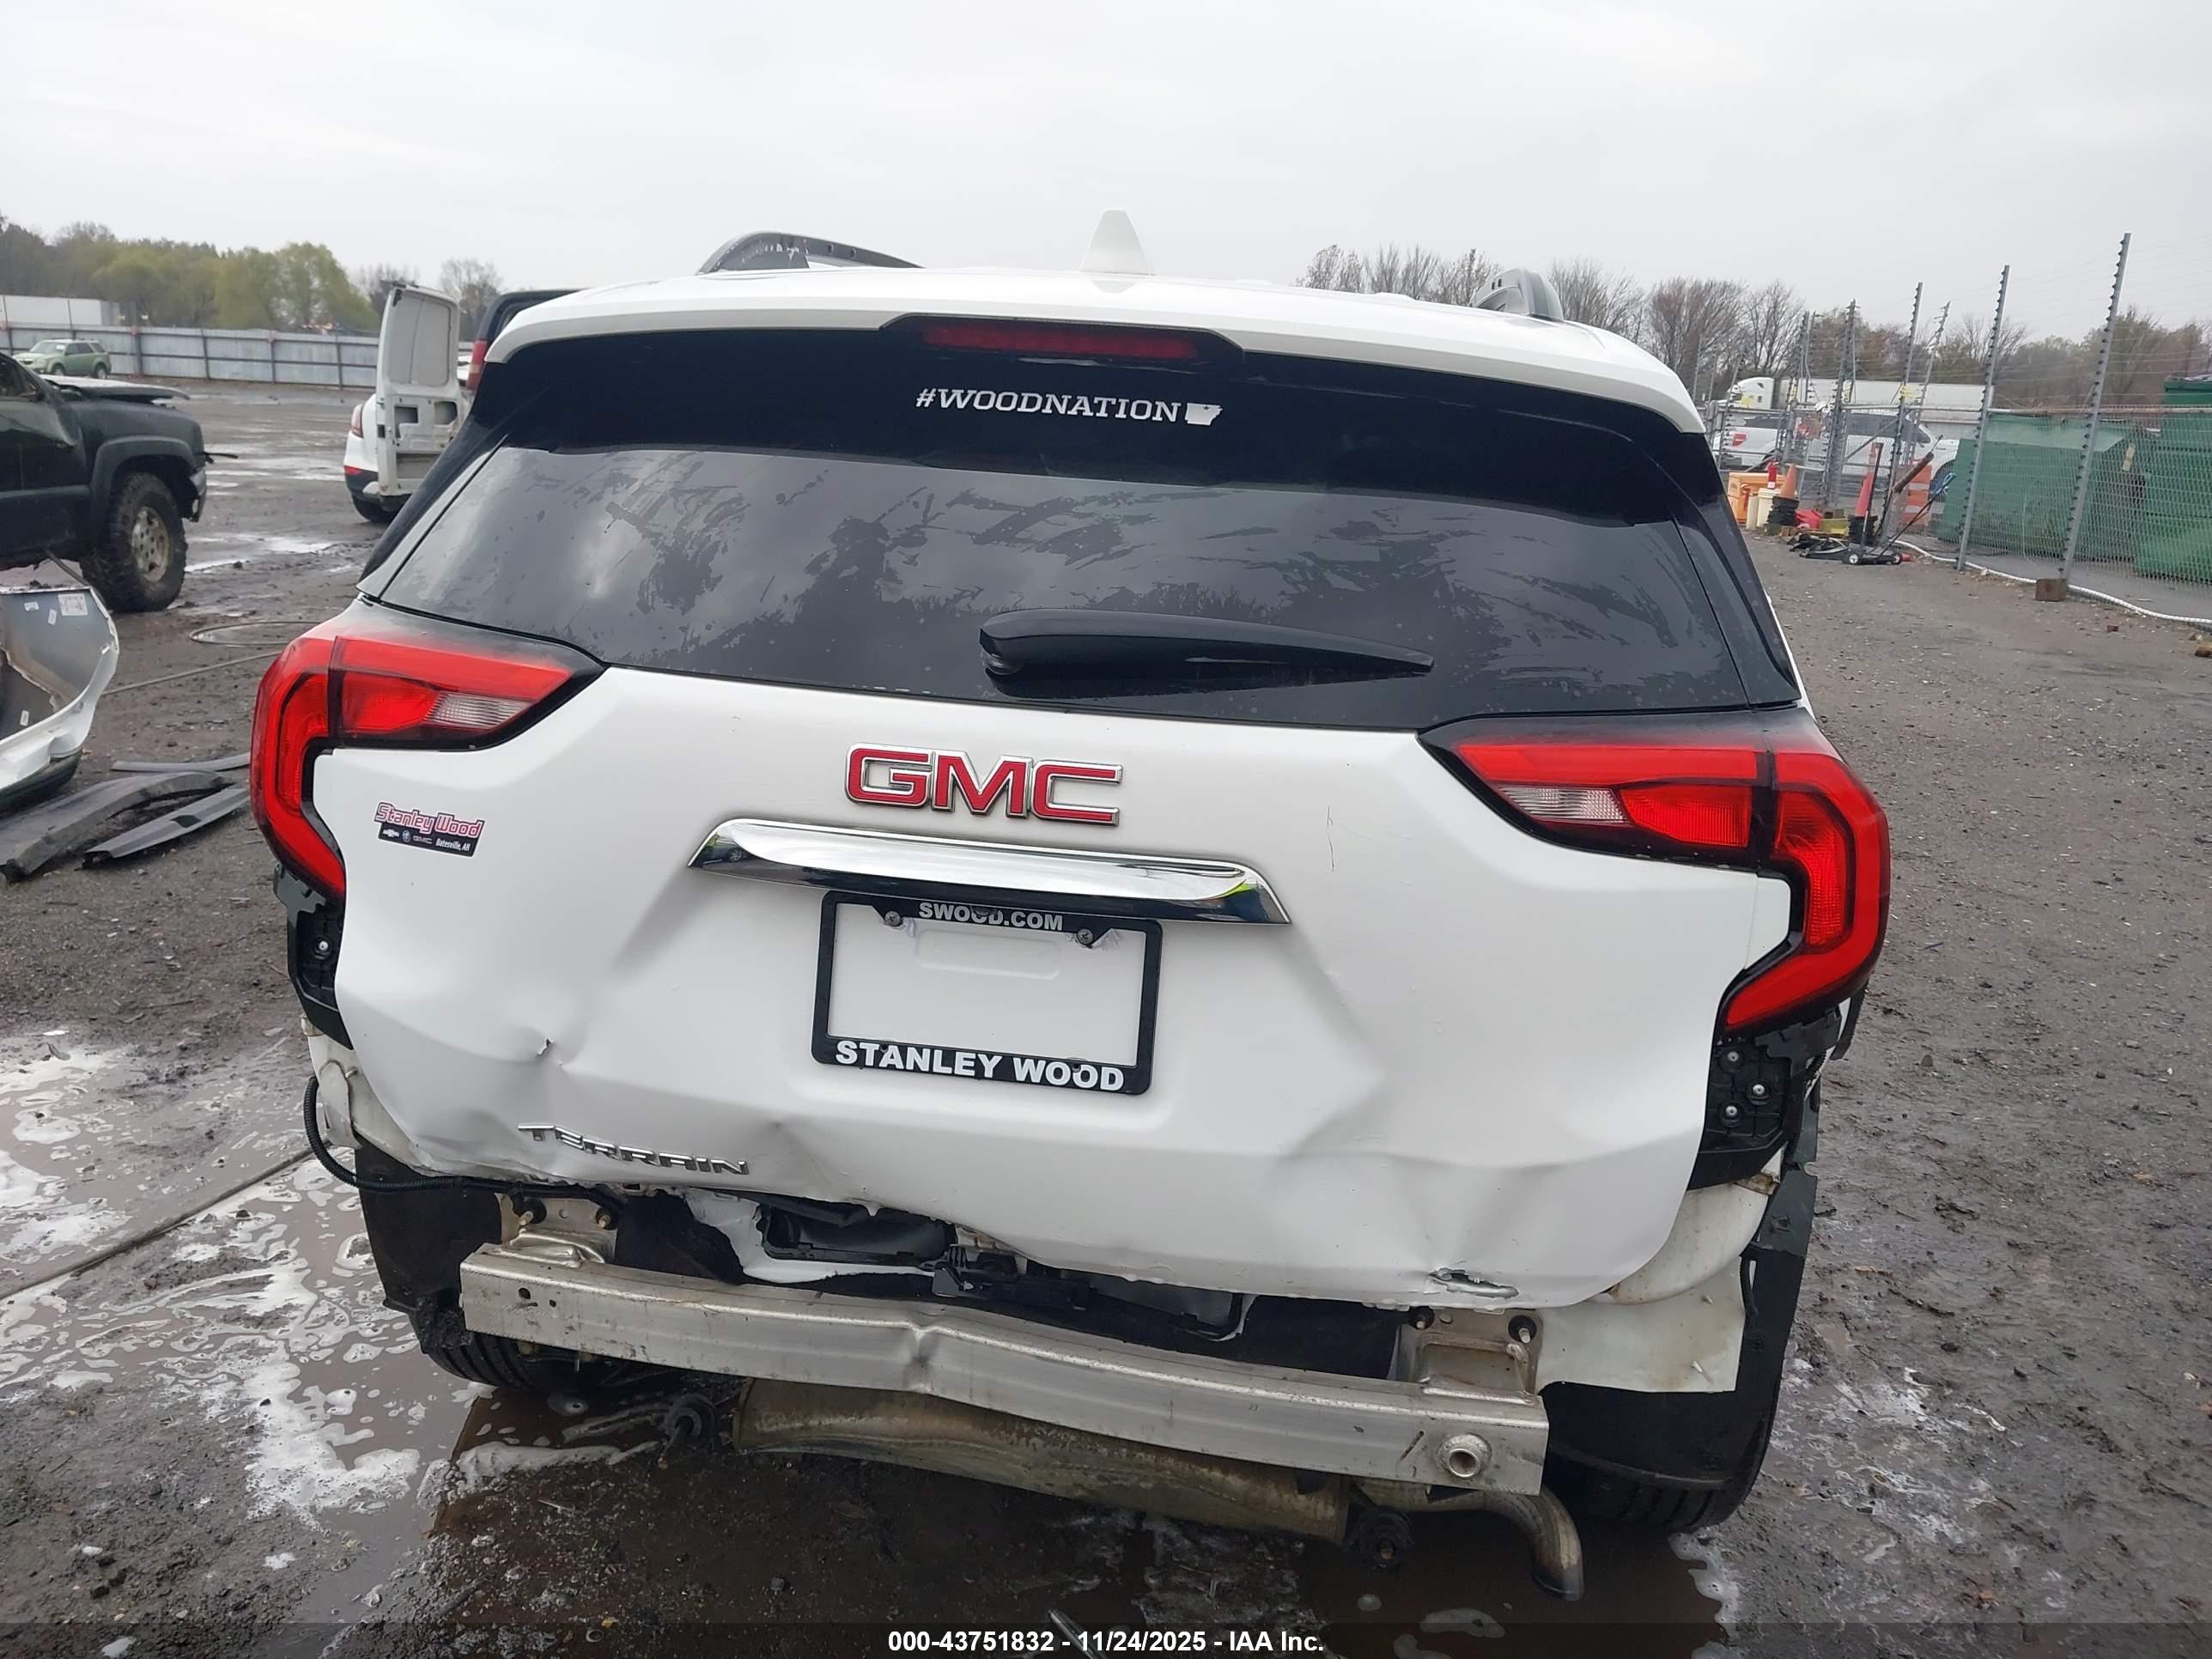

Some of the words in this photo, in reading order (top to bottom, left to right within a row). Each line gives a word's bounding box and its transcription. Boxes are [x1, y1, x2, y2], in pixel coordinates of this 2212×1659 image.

[915, 388, 1182, 422] #WOODNATION
[845, 743, 1123, 826] GMC
[376, 803, 434, 834] Stanley
[435, 813, 483, 837] Wood
[919, 902, 1063, 932] SWOOD.COM
[836, 1040, 1005, 1079] STANLEY
[1013, 1057, 1125, 1091] WOOD
[518, 1124, 750, 1175] TERRAIN
